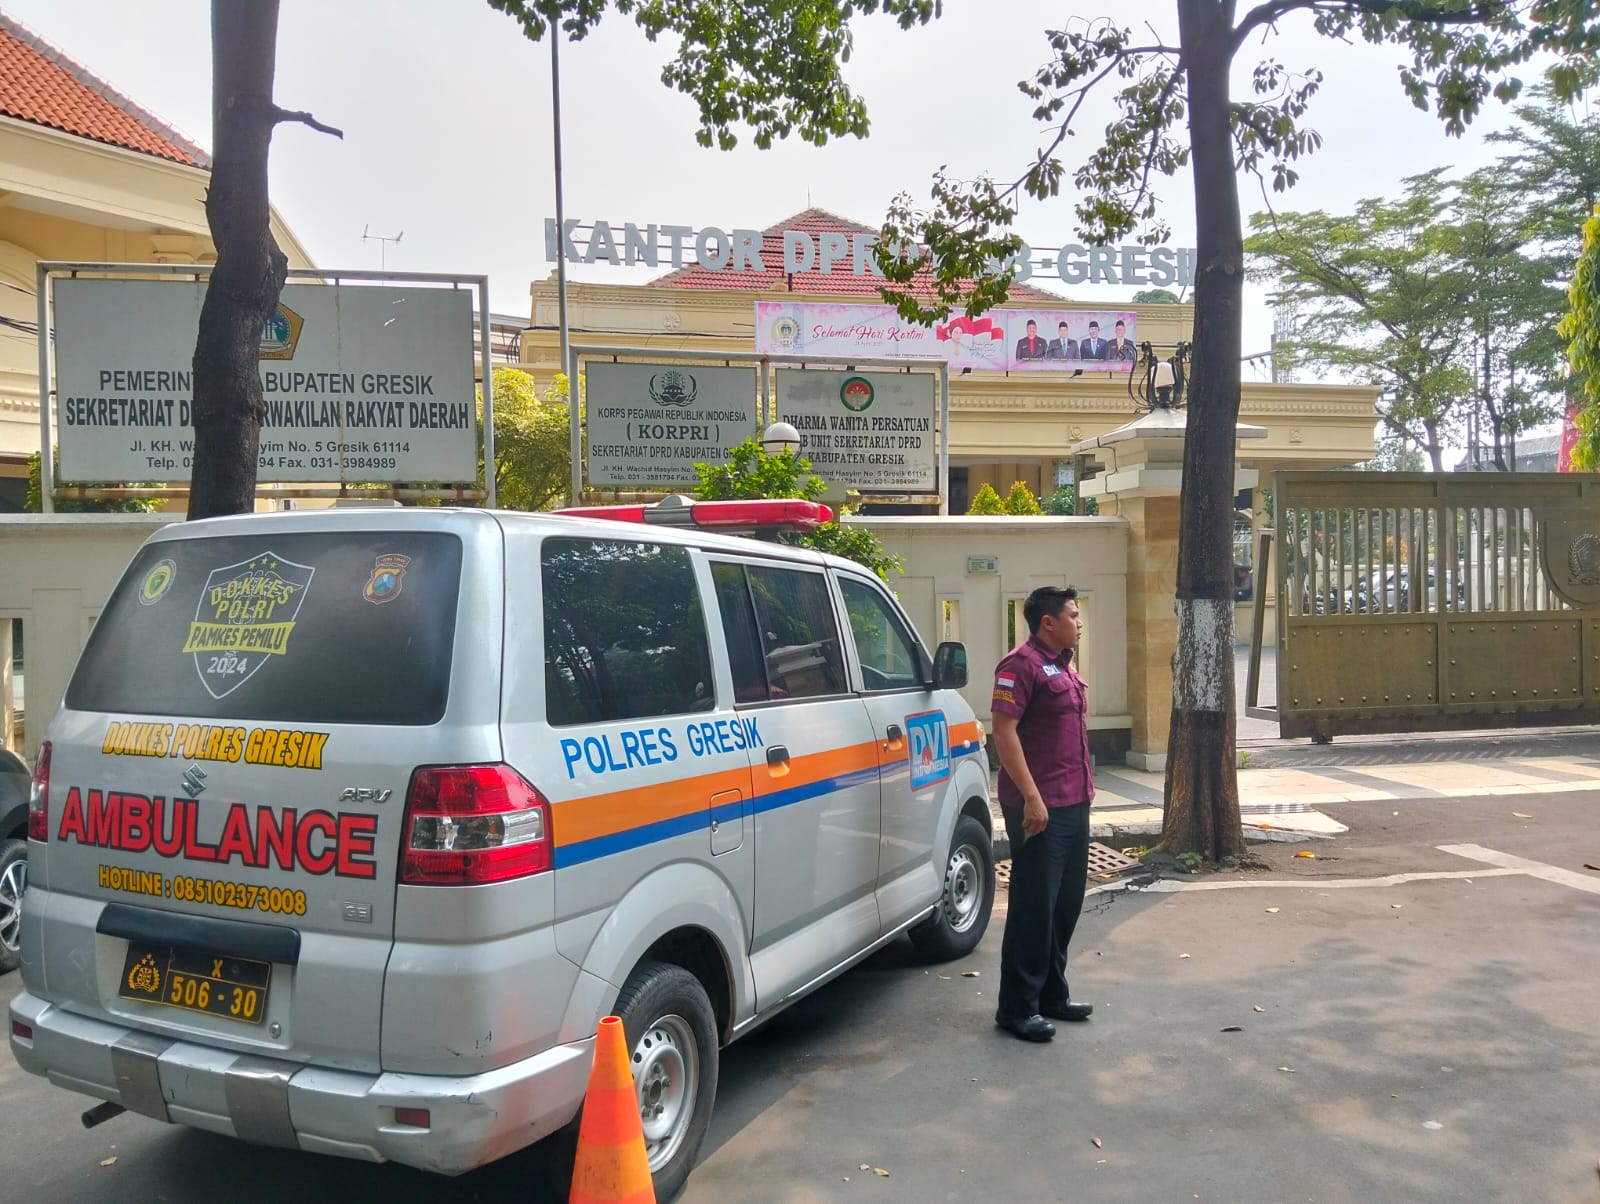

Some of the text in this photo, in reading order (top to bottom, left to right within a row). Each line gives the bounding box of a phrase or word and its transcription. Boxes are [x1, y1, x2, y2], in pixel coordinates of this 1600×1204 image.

[544, 218, 766, 272] KANTOR
[856, 326, 884, 340] Hari
[887, 326, 924, 341] Kartini
[101, 370, 434, 395] PEMERIN BUPATEN GRESIK
[66, 397, 174, 426] SEKRETARIAT
[262, 400, 341, 427] RWAKILAN
[346, 401, 404, 428] RAKYAT
[409, 402, 469, 429] DAERAH
[598, 408, 746, 422] KORPS PEGAWAI REPUBLIK INDONESIA
[782, 415, 929, 432] DHARMA WANITA PERSATUAN
[151, 440, 175, 451] KH.
[288, 441, 311, 453] No.
[315, 441, 323, 453] 5
[326, 441, 369, 453] Gresik
[373, 442, 410, 453] 61114
[811, 435, 831, 448] UNIT
[834, 435, 896, 449] SEKRETARIAT
[899, 436, 922, 449] DPRD
[592, 445, 648, 457] SEKRETARIAT
[650, 446, 671, 458] DPRD
[674, 447, 721, 459] KABUPATEN
[808, 452, 905, 465] KABUPATEN GRESIK
[146, 457, 178, 470] Telp.
[279, 457, 306, 468] Fax.
[343, 458, 396, 469] 3984989
[211, 577, 293, 605] DOKKES
[215, 600, 275, 619] POLRI
[191, 625, 287, 650] PAMKES PEMILU
[207, 657, 247, 674] 2024
[102, 721, 330, 770] DOKKES POLRES GRESIK
[560, 716, 764, 780] POLRES GRESIK
[909, 720, 949, 763] DVI
[339, 786, 393, 803] APV
[57, 786, 379, 880] AMBULANCE
[173, 875, 307, 916] 085102373008
[212, 959, 224, 978] X
